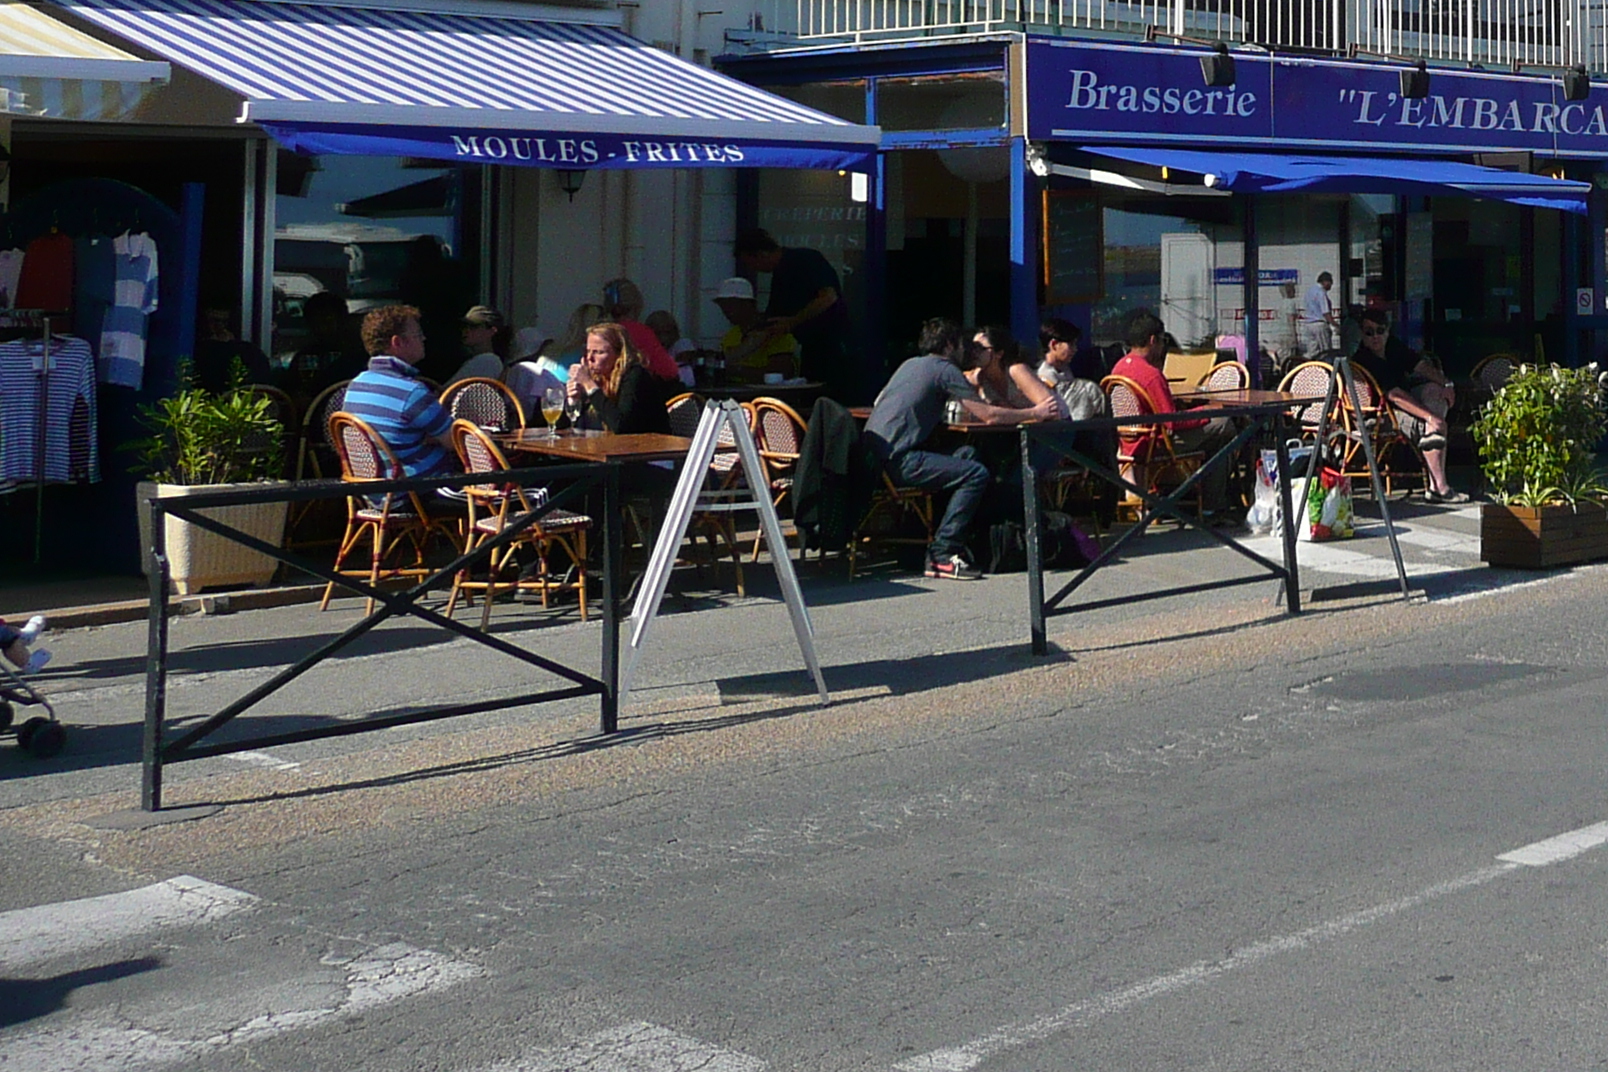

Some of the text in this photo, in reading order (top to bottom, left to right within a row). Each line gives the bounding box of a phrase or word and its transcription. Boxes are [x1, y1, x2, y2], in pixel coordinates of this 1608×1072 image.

[1064, 68, 1257, 117] Brasserie
[450, 134, 599, 164] MOULES
[622, 140, 745, 163] FRITES
